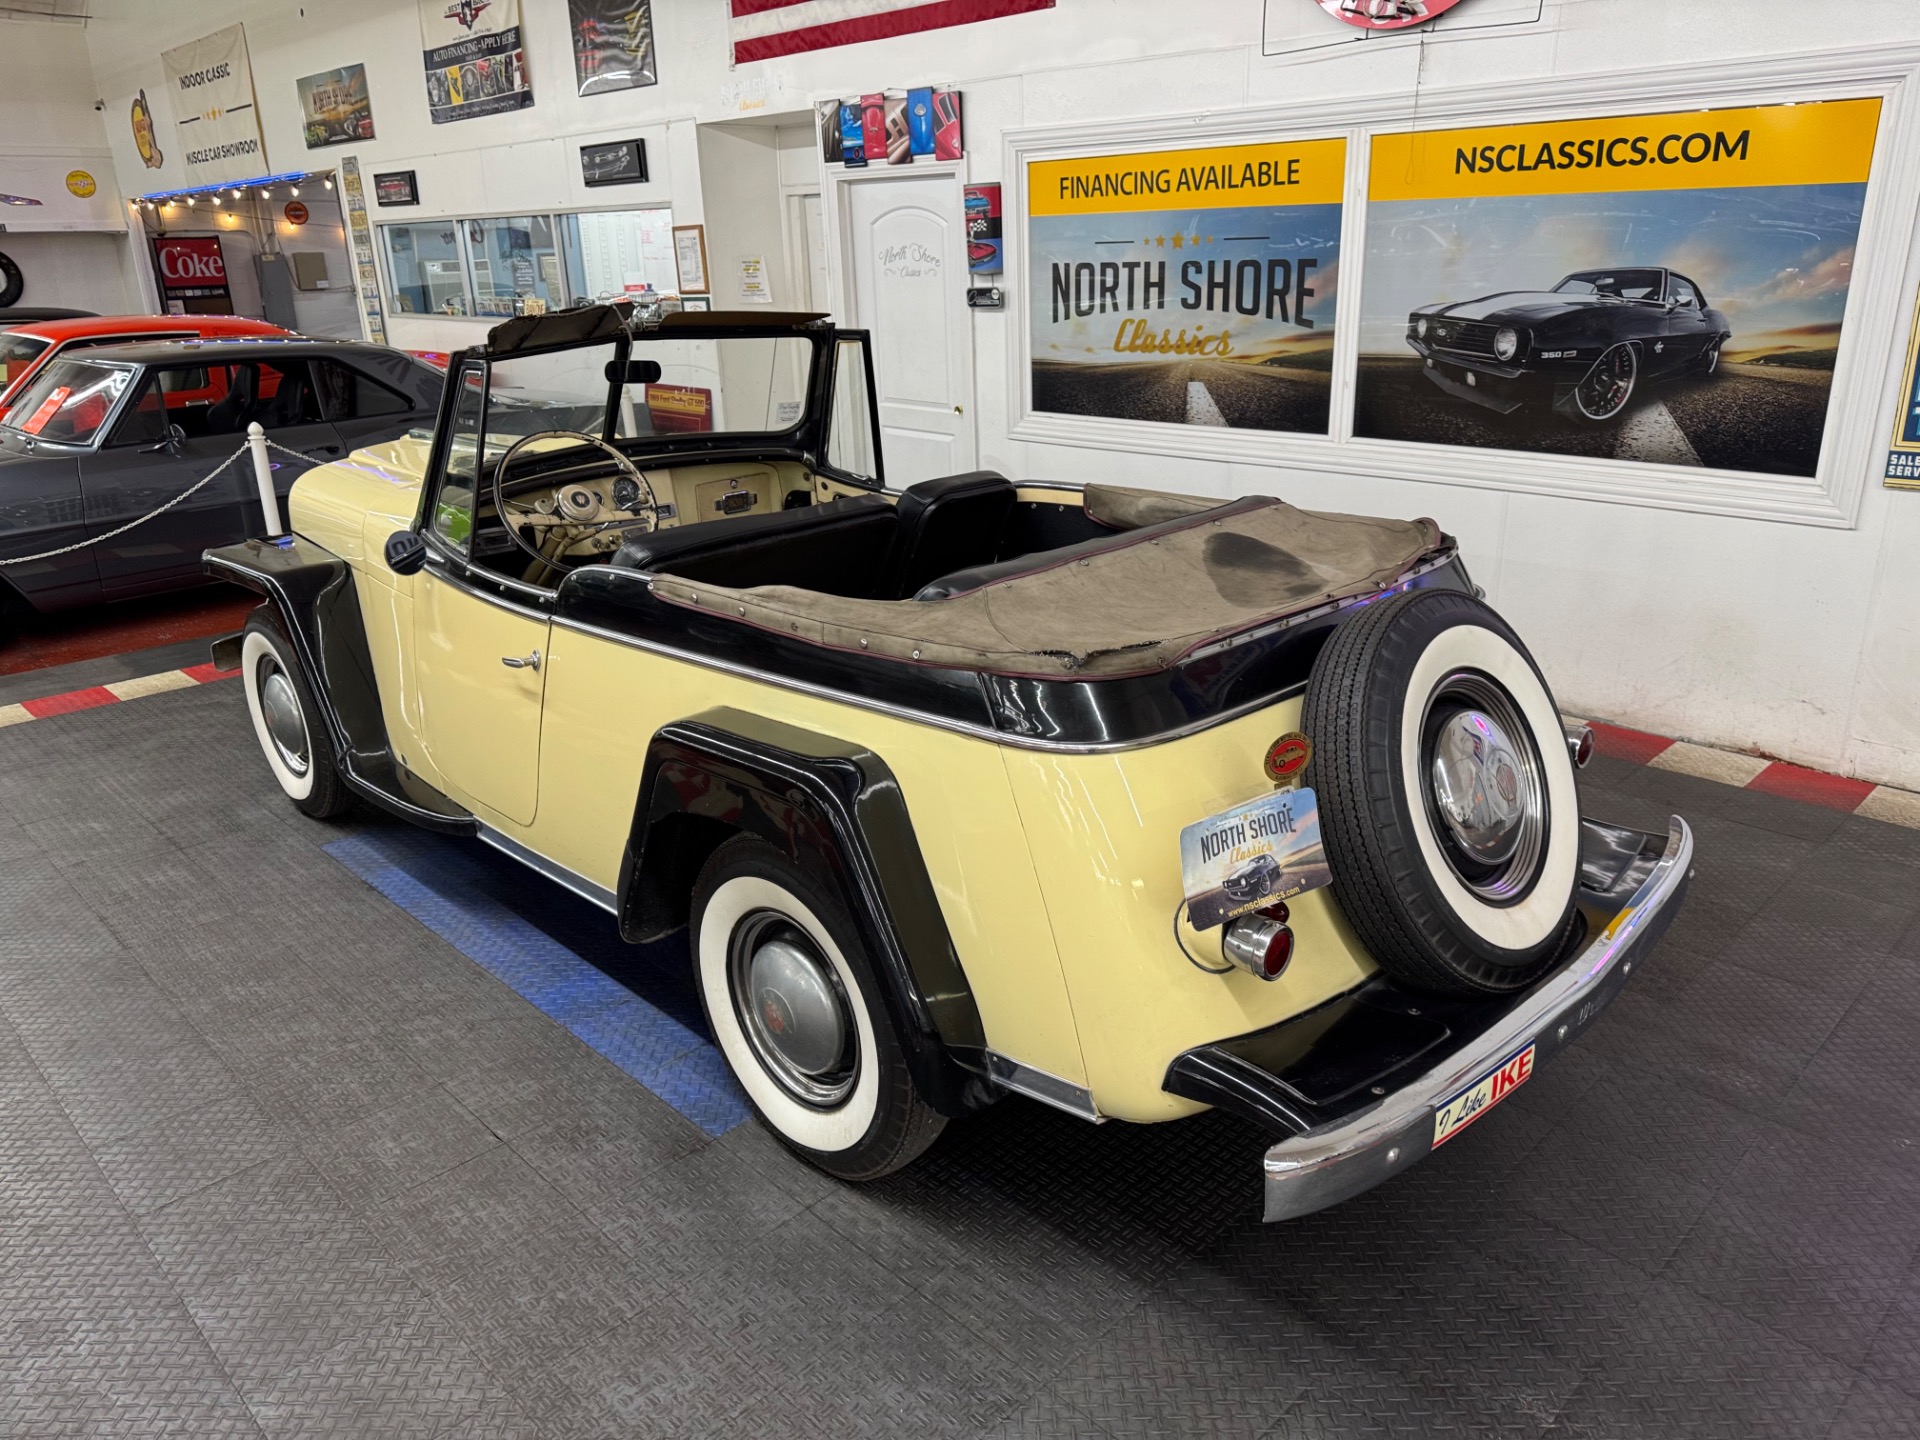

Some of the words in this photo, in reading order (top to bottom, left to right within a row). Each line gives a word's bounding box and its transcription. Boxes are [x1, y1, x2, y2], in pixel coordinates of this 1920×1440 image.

[433, 51, 448, 62] AUTO
[448, 41, 479, 59] FINANCING
[480, 36, 502, 51] APPLY
[502, 30, 517, 45] HERE
[179, 70, 205, 90] INDOOR
[206, 62, 230, 83] CLASSIC
[186, 148, 209, 166] MUSCLE
[209, 146, 222, 162] CAR
[222, 138, 259, 158] SHOWROOM
[1454, 129, 1751, 175] NSCLASSICS.COM
[1059, 168, 1171, 200] FINANCING
[1176, 158, 1301, 193] AVAILABLE
[159, 247, 225, 279] Coke
[879, 245, 908, 265] North
[1051, 260, 1167, 324] NORTH
[1180, 257, 1318, 329] SHORE
[1113, 318, 1235, 357] Classics
[1200, 824, 1247, 864] NORTH
[1250, 806, 1297, 840] SHORE
[1228, 840, 1274, 865] Classics
[1227, 886, 1300, 918] www.nsclassics.com
[1452, 1088, 1487, 1128] Like
[1490, 1047, 1533, 1102] IKE
